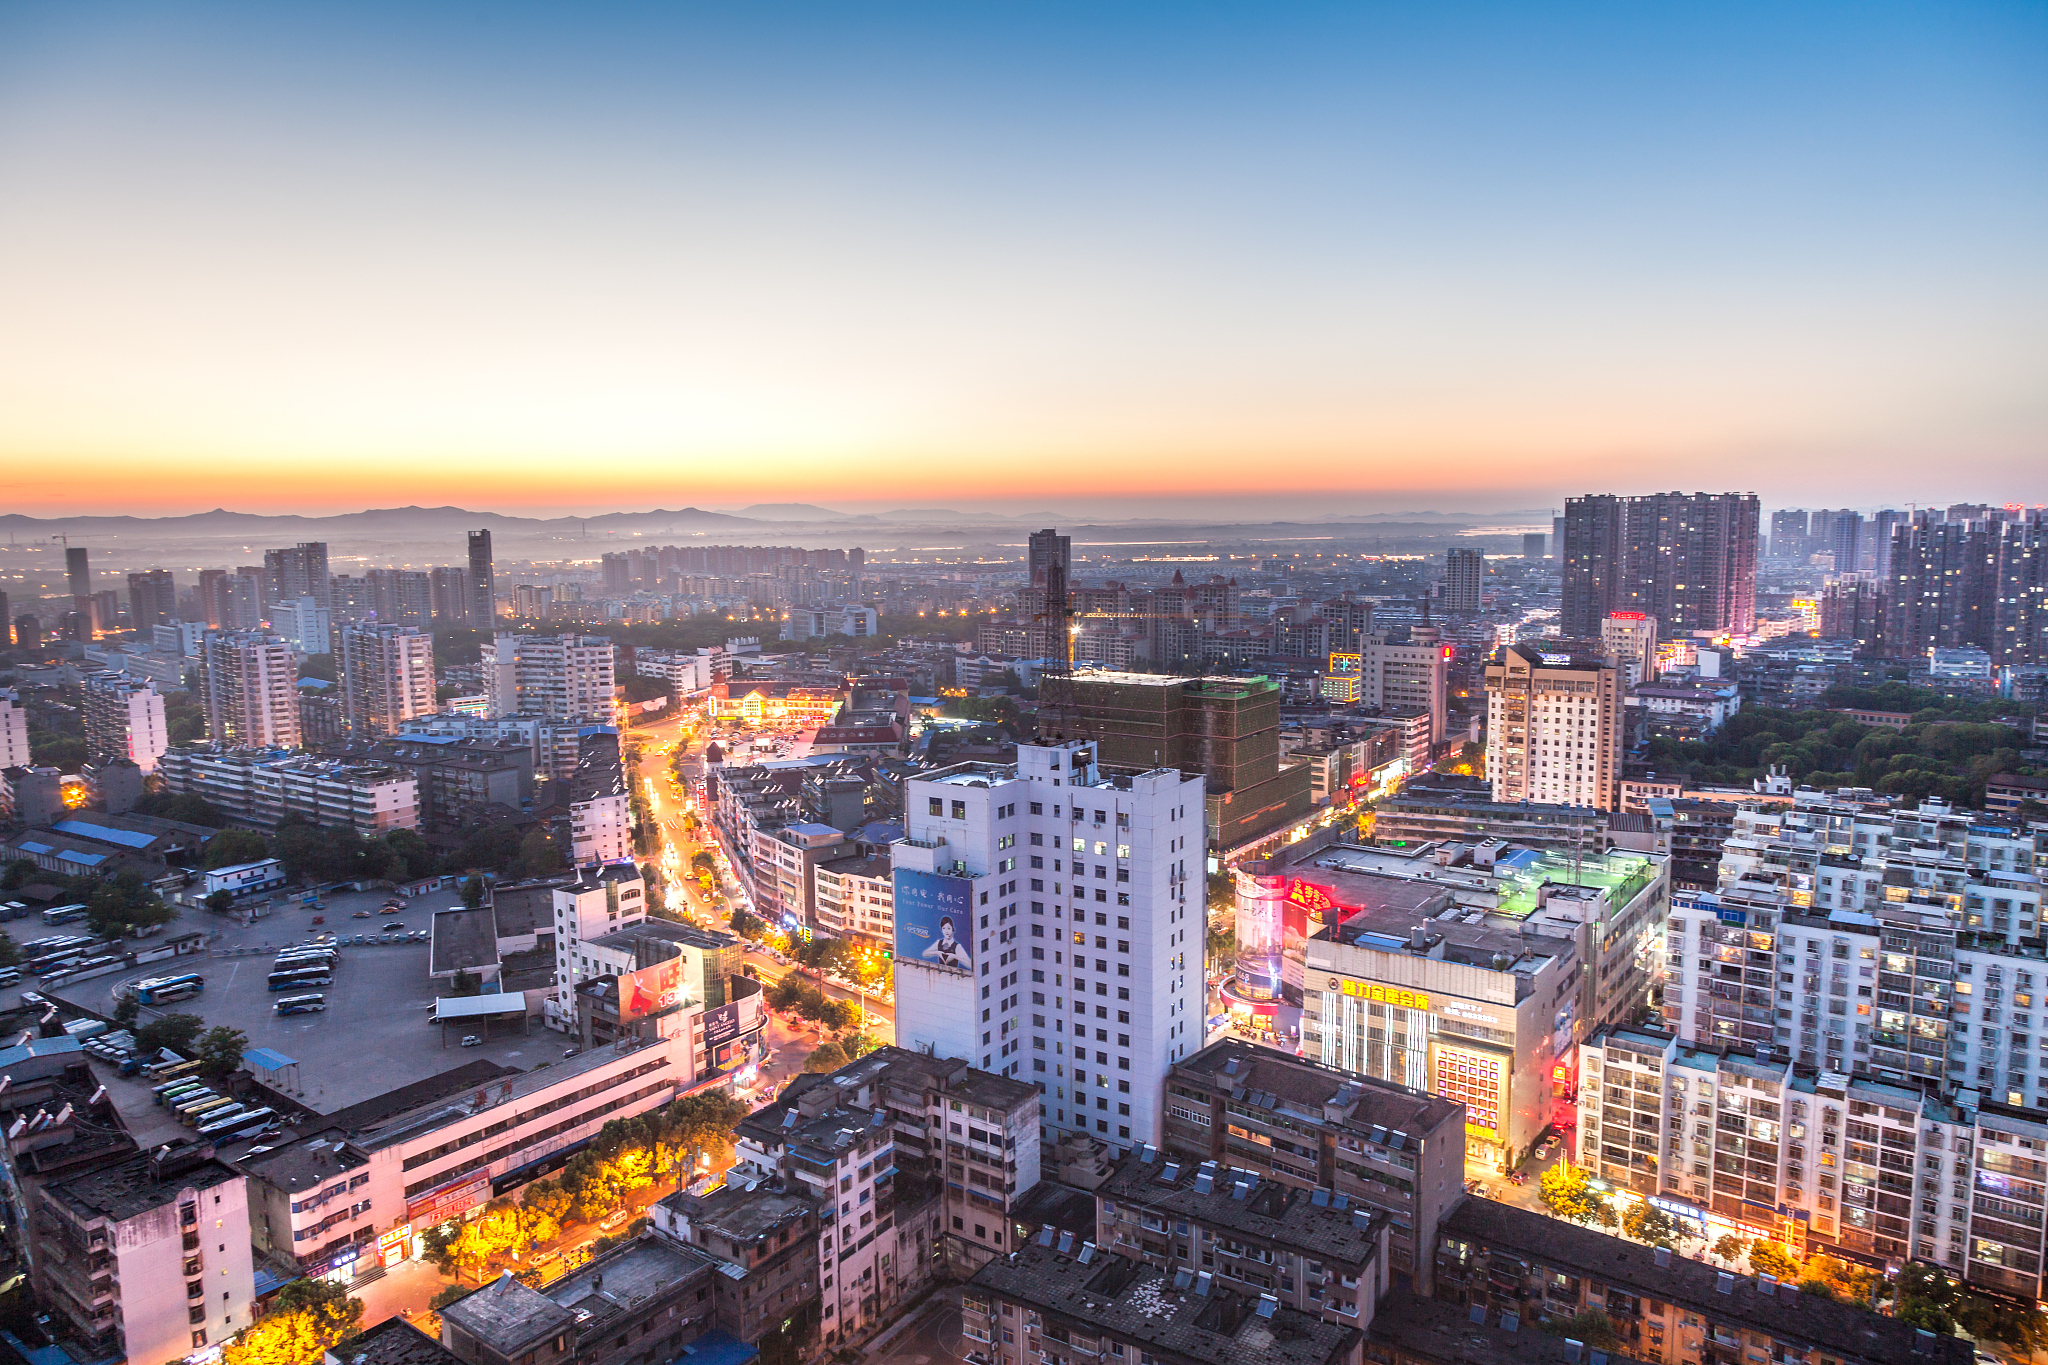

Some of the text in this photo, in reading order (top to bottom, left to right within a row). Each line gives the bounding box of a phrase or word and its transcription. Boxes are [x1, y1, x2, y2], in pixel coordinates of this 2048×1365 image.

[917, 901, 934, 909] Power
[937, 904, 949, 912] Our
[950, 907, 964, 915] Care
[1342, 979, 1429, 1011] 魅力金座会所
